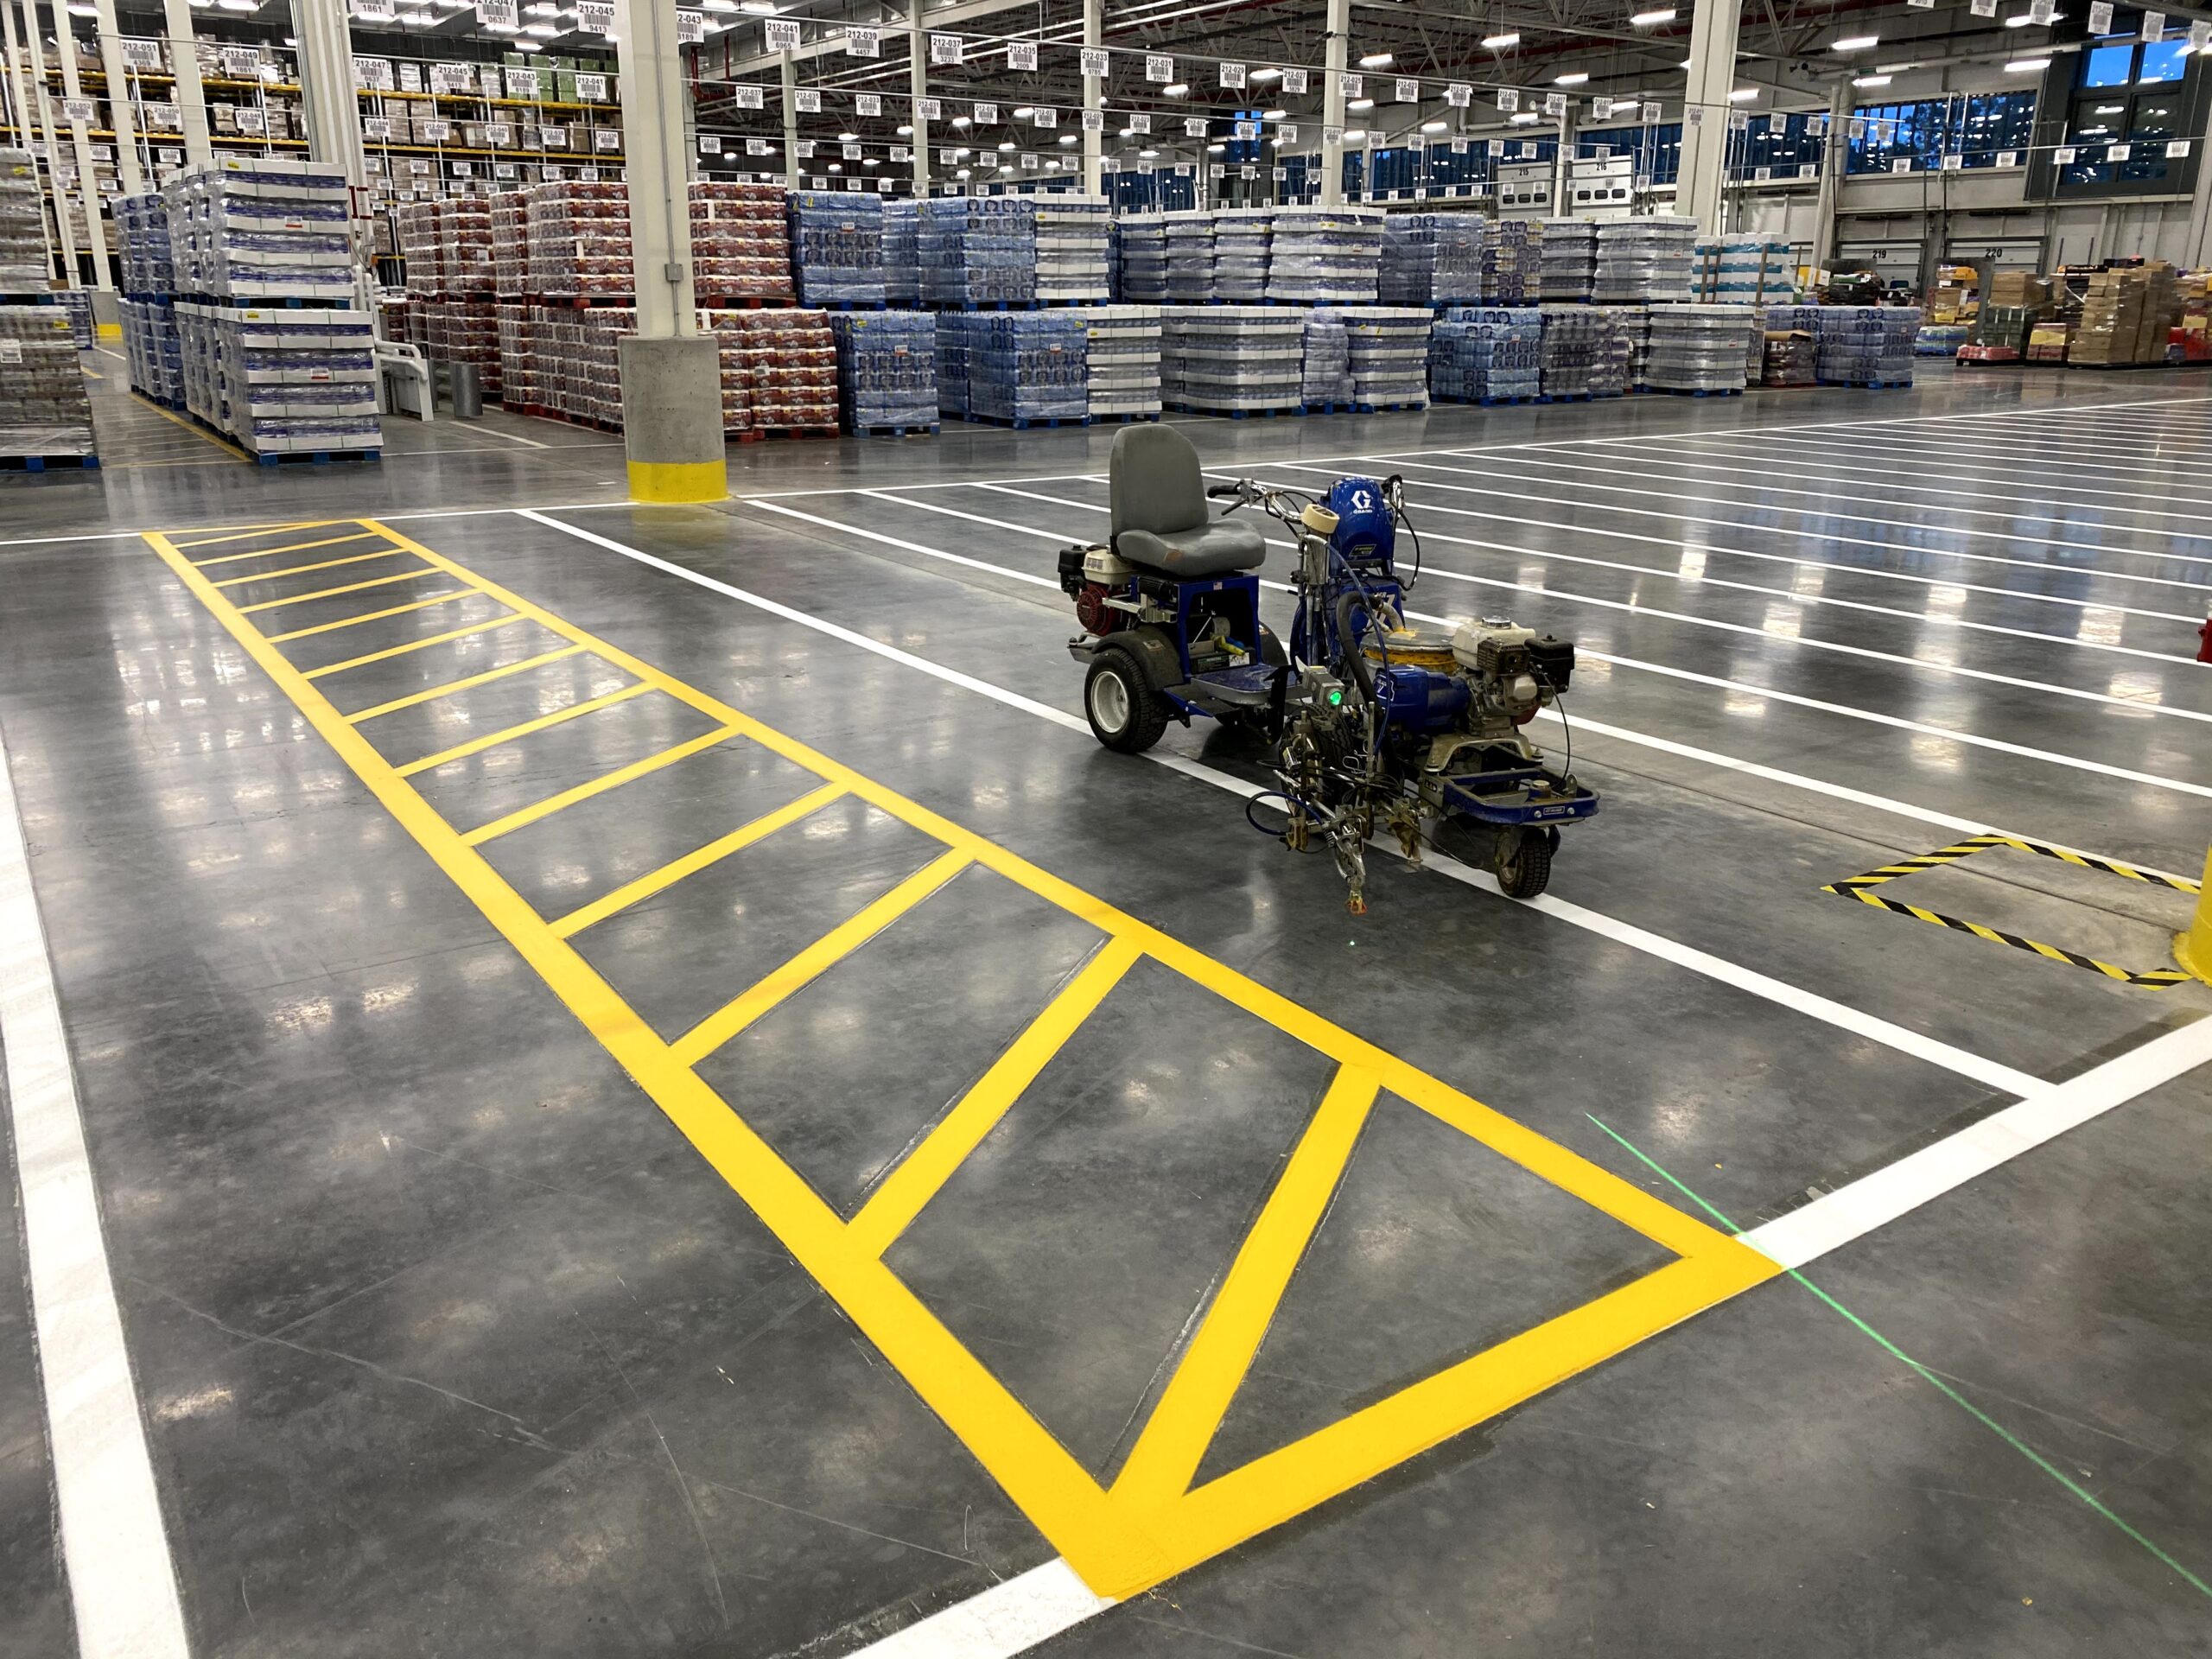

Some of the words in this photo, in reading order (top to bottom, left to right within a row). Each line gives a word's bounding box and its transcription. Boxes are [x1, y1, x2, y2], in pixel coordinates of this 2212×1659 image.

[363, 4, 382, 13] 1861
[578, 3, 614, 16] 212-045
[487, 16, 506, 24] 0637
[677, 14, 702, 24] 2-043
[766, 22, 798, 34] 212-041
[847, 30, 877, 40] 212-039
[122, 42, 156, 52] 212-051
[932, 38, 961, 48] 212-037
[1009, 45, 1036, 54] 212-035
[225, 50, 257, 60] 212-049
[1082, 51, 1108, 61] 212-033
[355, 60, 385, 69] 212-047
[1147, 58, 1172, 67] 212-031
[438, 66, 468, 75] 212-045
[1221, 65, 1244, 73] 212-029
[507, 71, 536, 80] 212-043
[1340, 75, 1362, 84] 212-025
[576, 77, 603, 86] 212-041
[1397, 80, 1418, 89] 212-023
[64, 102, 91, 111] 212-052
[1596, 162, 1607, 171] 216
[1519, 168, 1529, 176] 215
[1872, 249, 1887, 258] 219
[1985, 248, 2003, 258] 220
